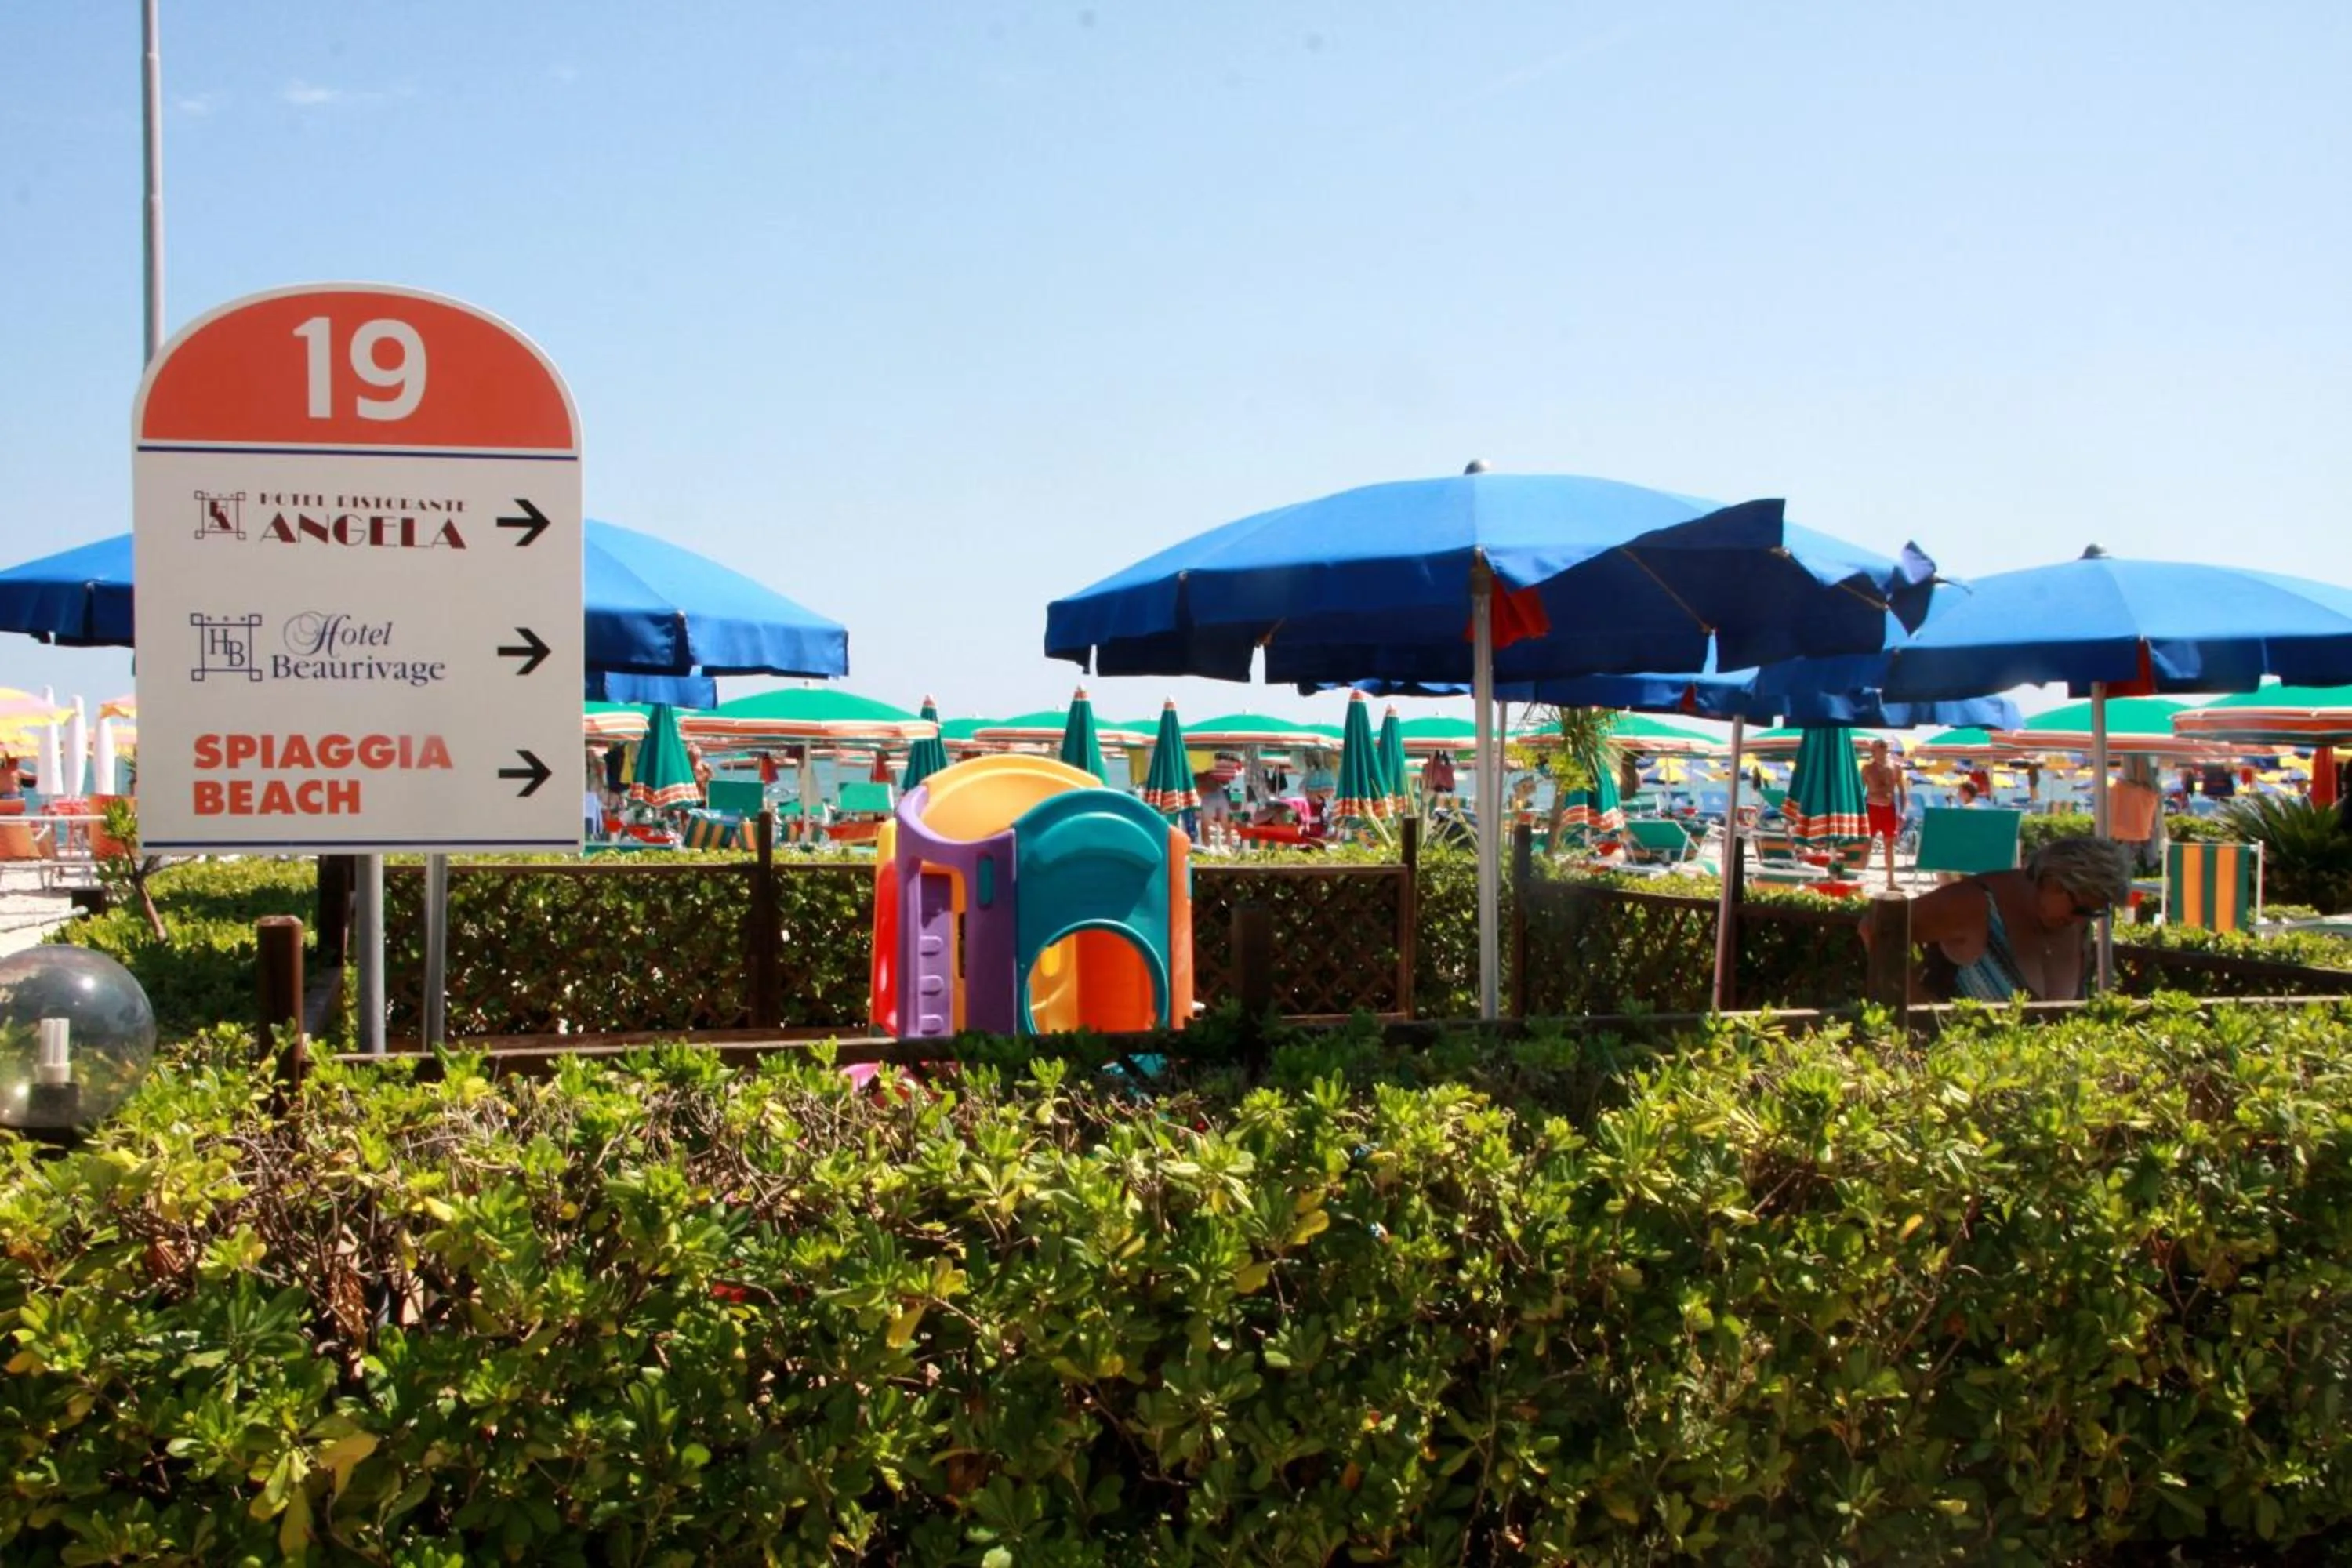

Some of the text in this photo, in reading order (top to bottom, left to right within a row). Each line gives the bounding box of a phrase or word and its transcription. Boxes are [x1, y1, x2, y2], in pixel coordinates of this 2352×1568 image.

[292, 316, 428, 422] 19
[260, 511, 467, 550] ANGELA
[283, 611, 394, 659] Hotel
[271, 654, 446, 688] Beaurivage
[193, 734, 454, 770] SPIAGGIA
[193, 780, 361, 815] BEACH
